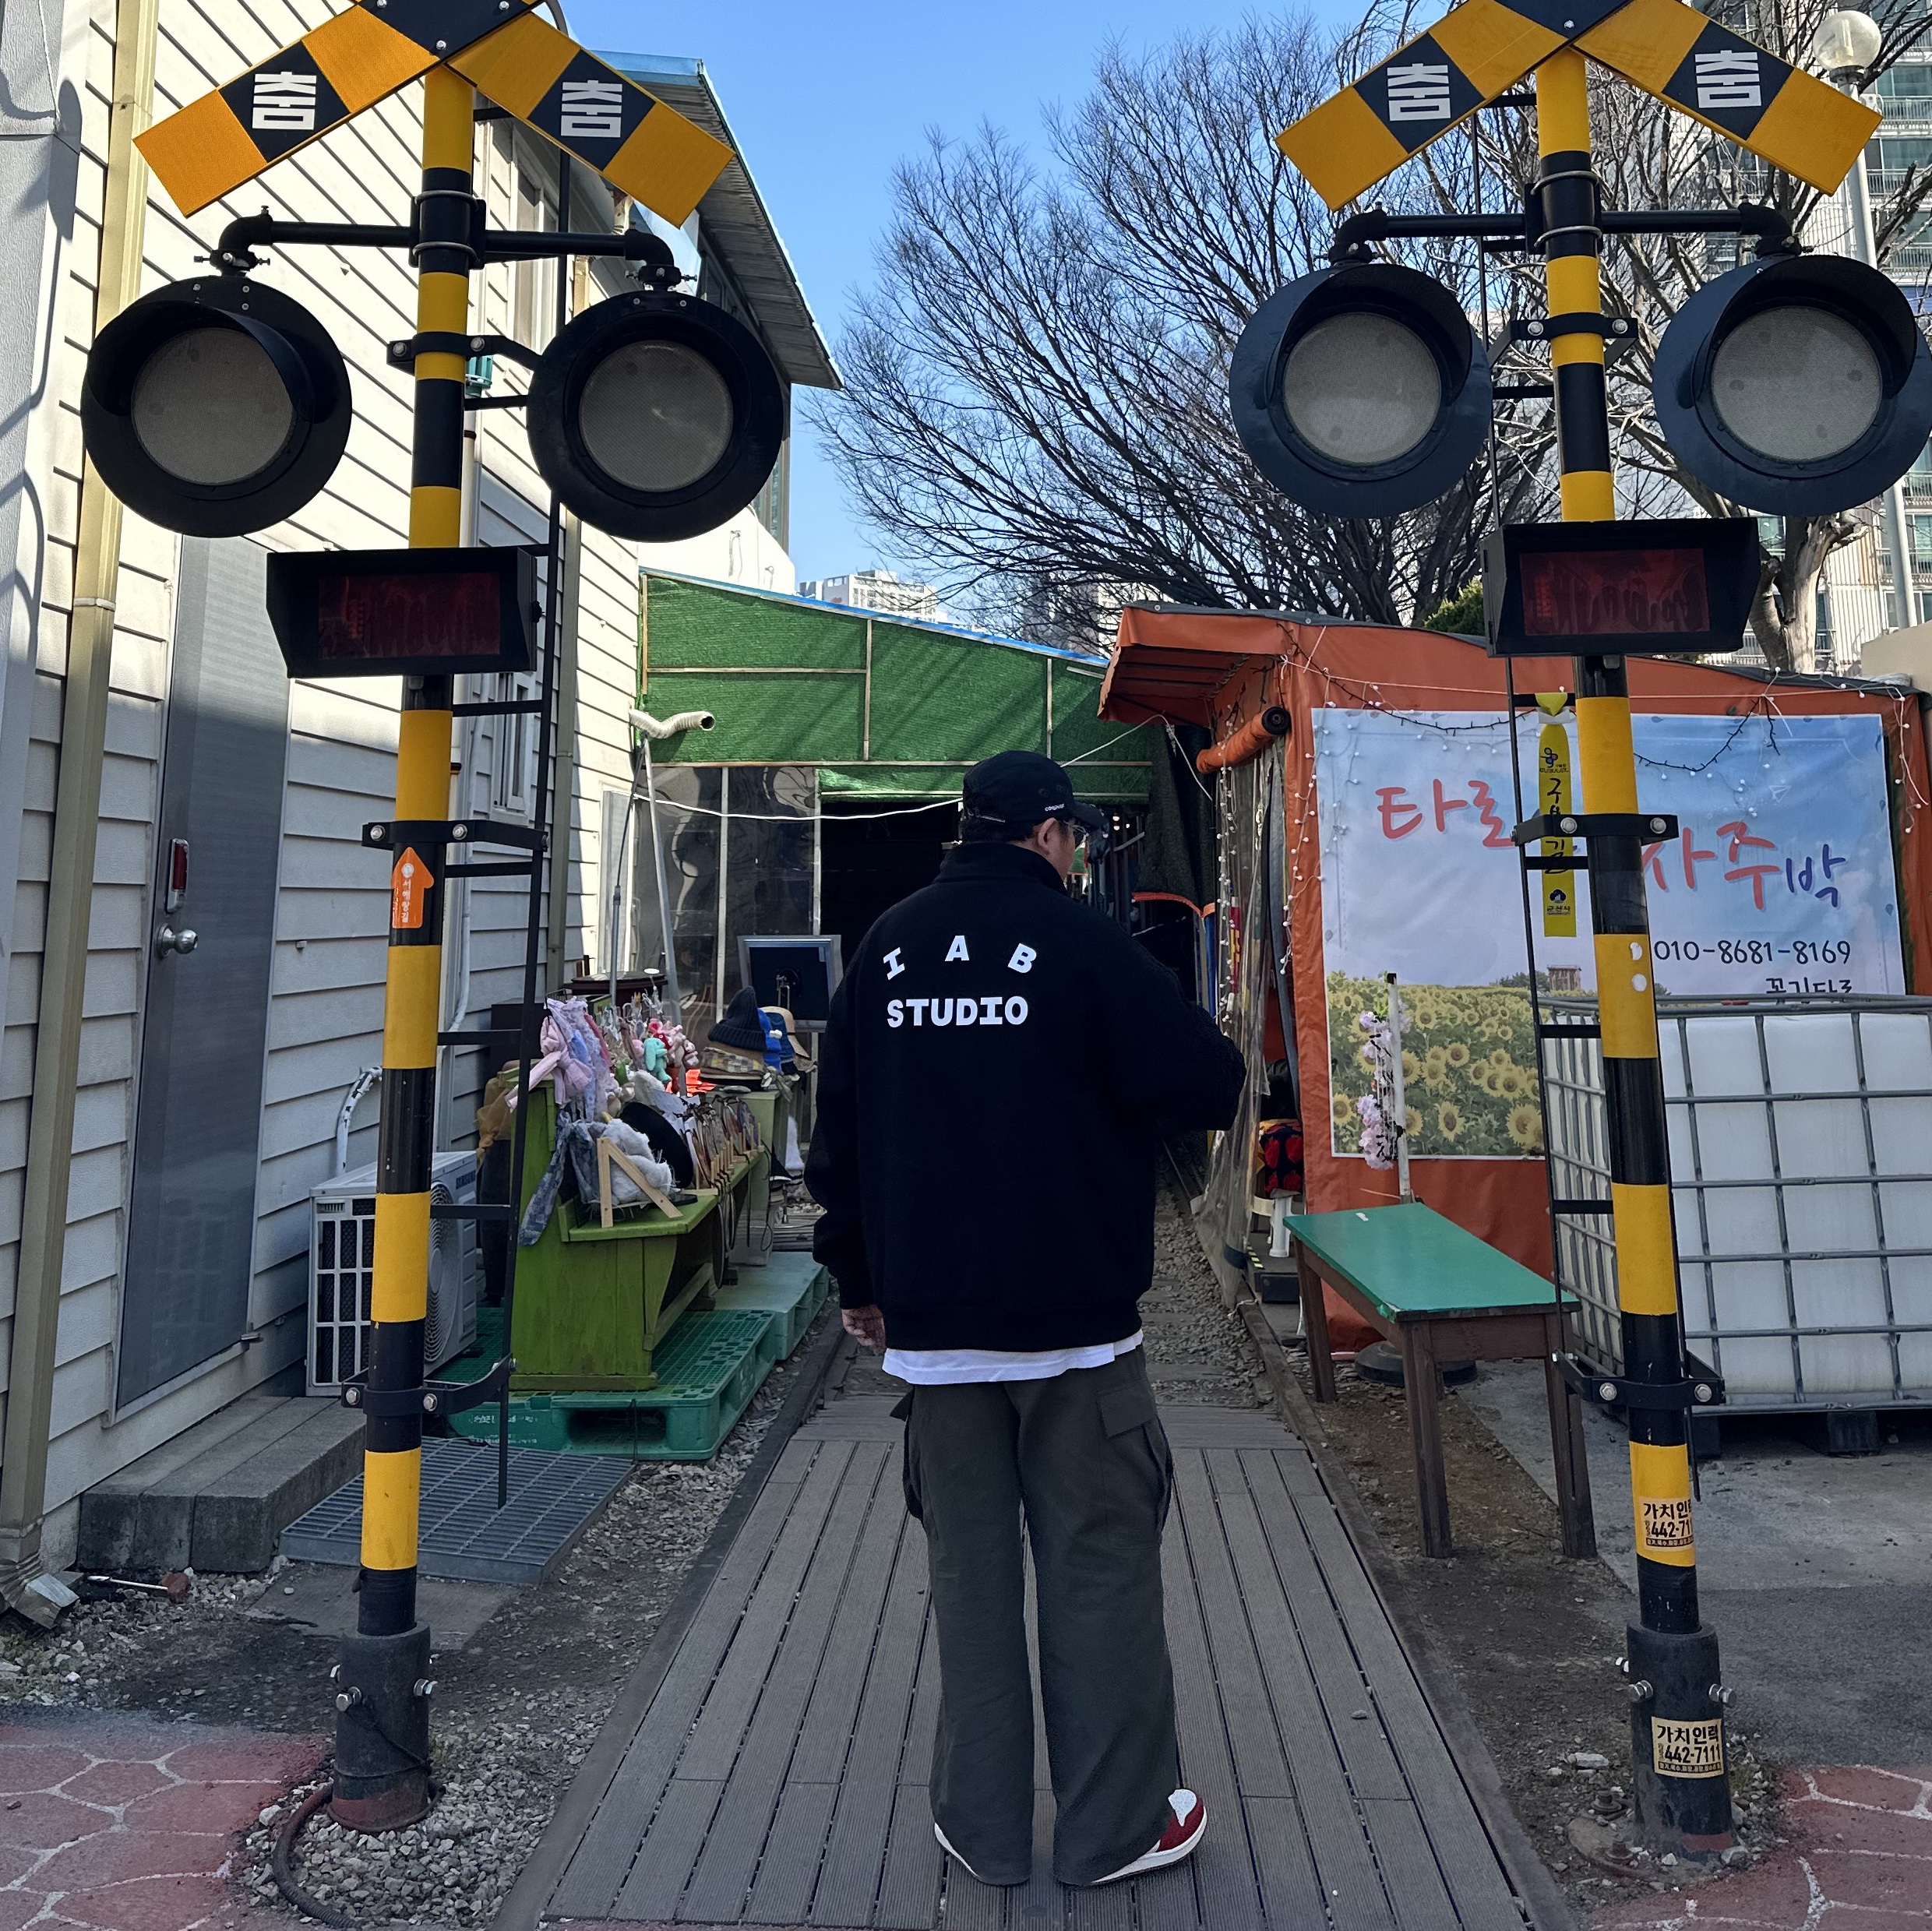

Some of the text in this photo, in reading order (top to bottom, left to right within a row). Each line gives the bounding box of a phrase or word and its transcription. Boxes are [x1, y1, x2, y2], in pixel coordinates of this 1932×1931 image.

[252, 72, 317, 130] 춤
[1387, 63, 1451, 122] 춤
[1695, 50, 1762, 108] 춤
[561, 80, 622, 138] 춤
[1376, 779, 1846, 910] 타로 사주 박
[1654, 939, 1851, 964] 010-8681-8169
[887, 995, 1028, 1028] STUDIO
